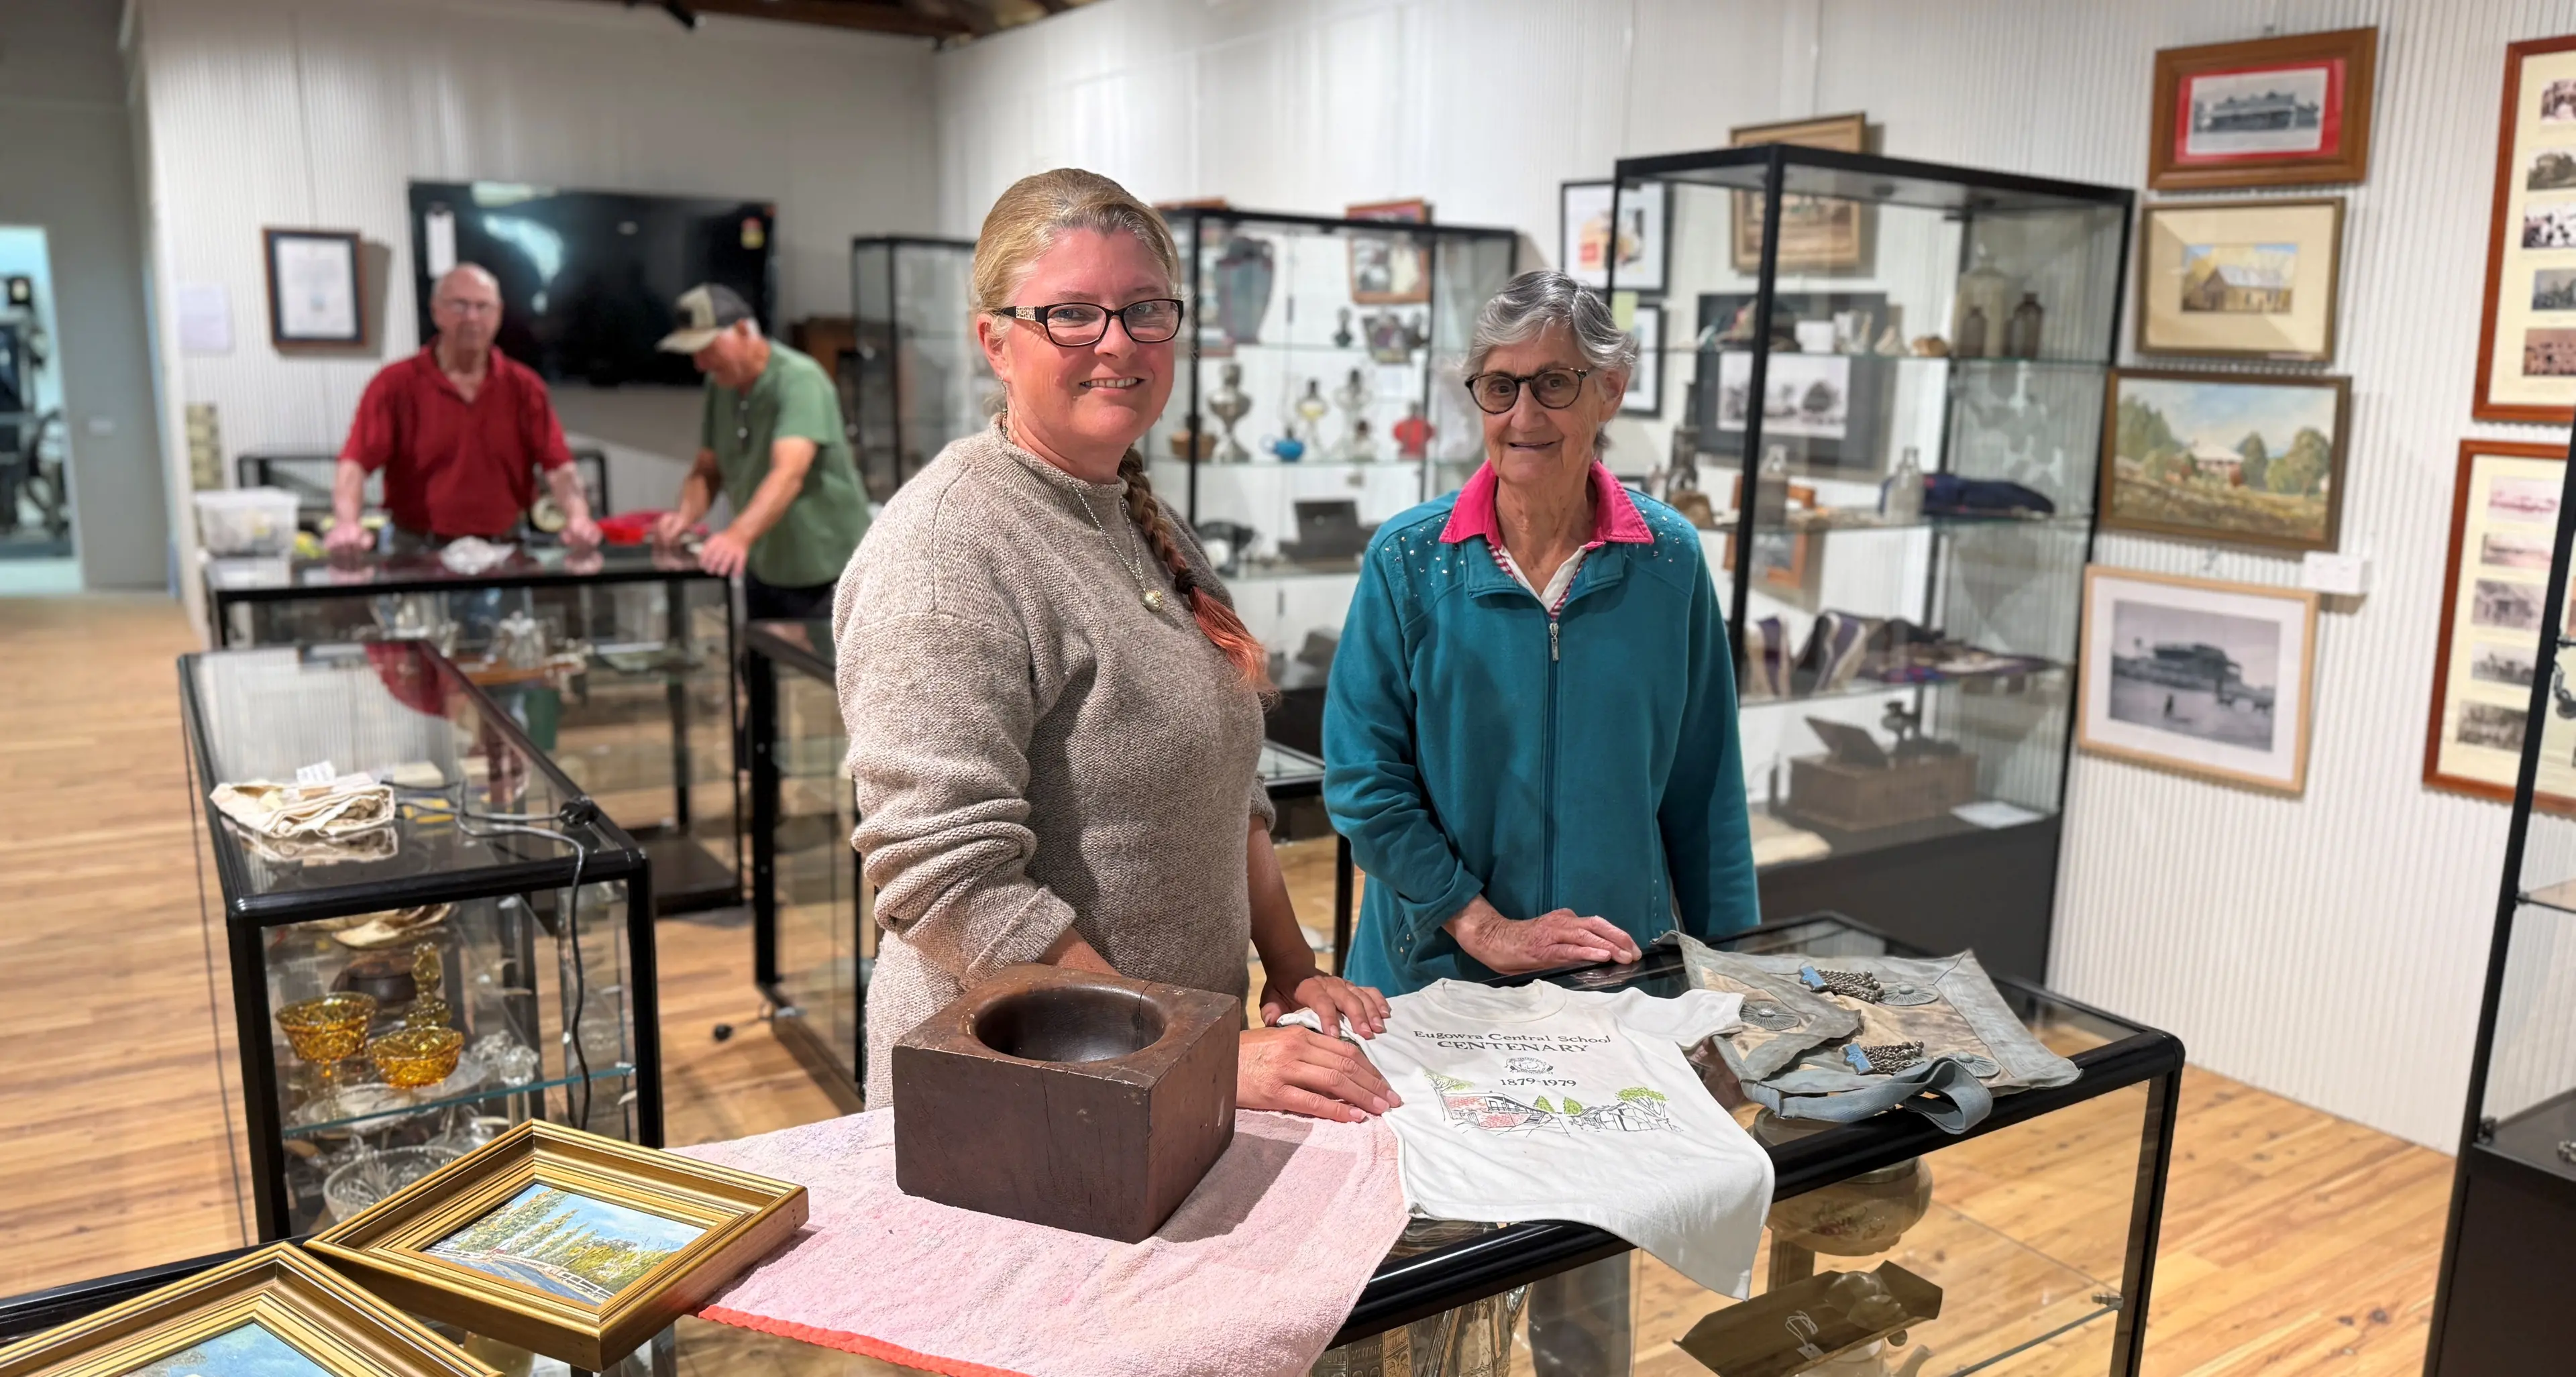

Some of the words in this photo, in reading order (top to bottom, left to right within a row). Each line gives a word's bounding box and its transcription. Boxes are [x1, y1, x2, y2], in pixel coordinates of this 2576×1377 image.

[1413, 1030, 1484, 1040] Eugowra
[1488, 1034, 1552, 1042] Central
[1557, 1035, 1611, 1044] School
[1437, 1040, 1589, 1052] CENTENARY
[1500, 1077, 1576, 1087] 1879-1979
